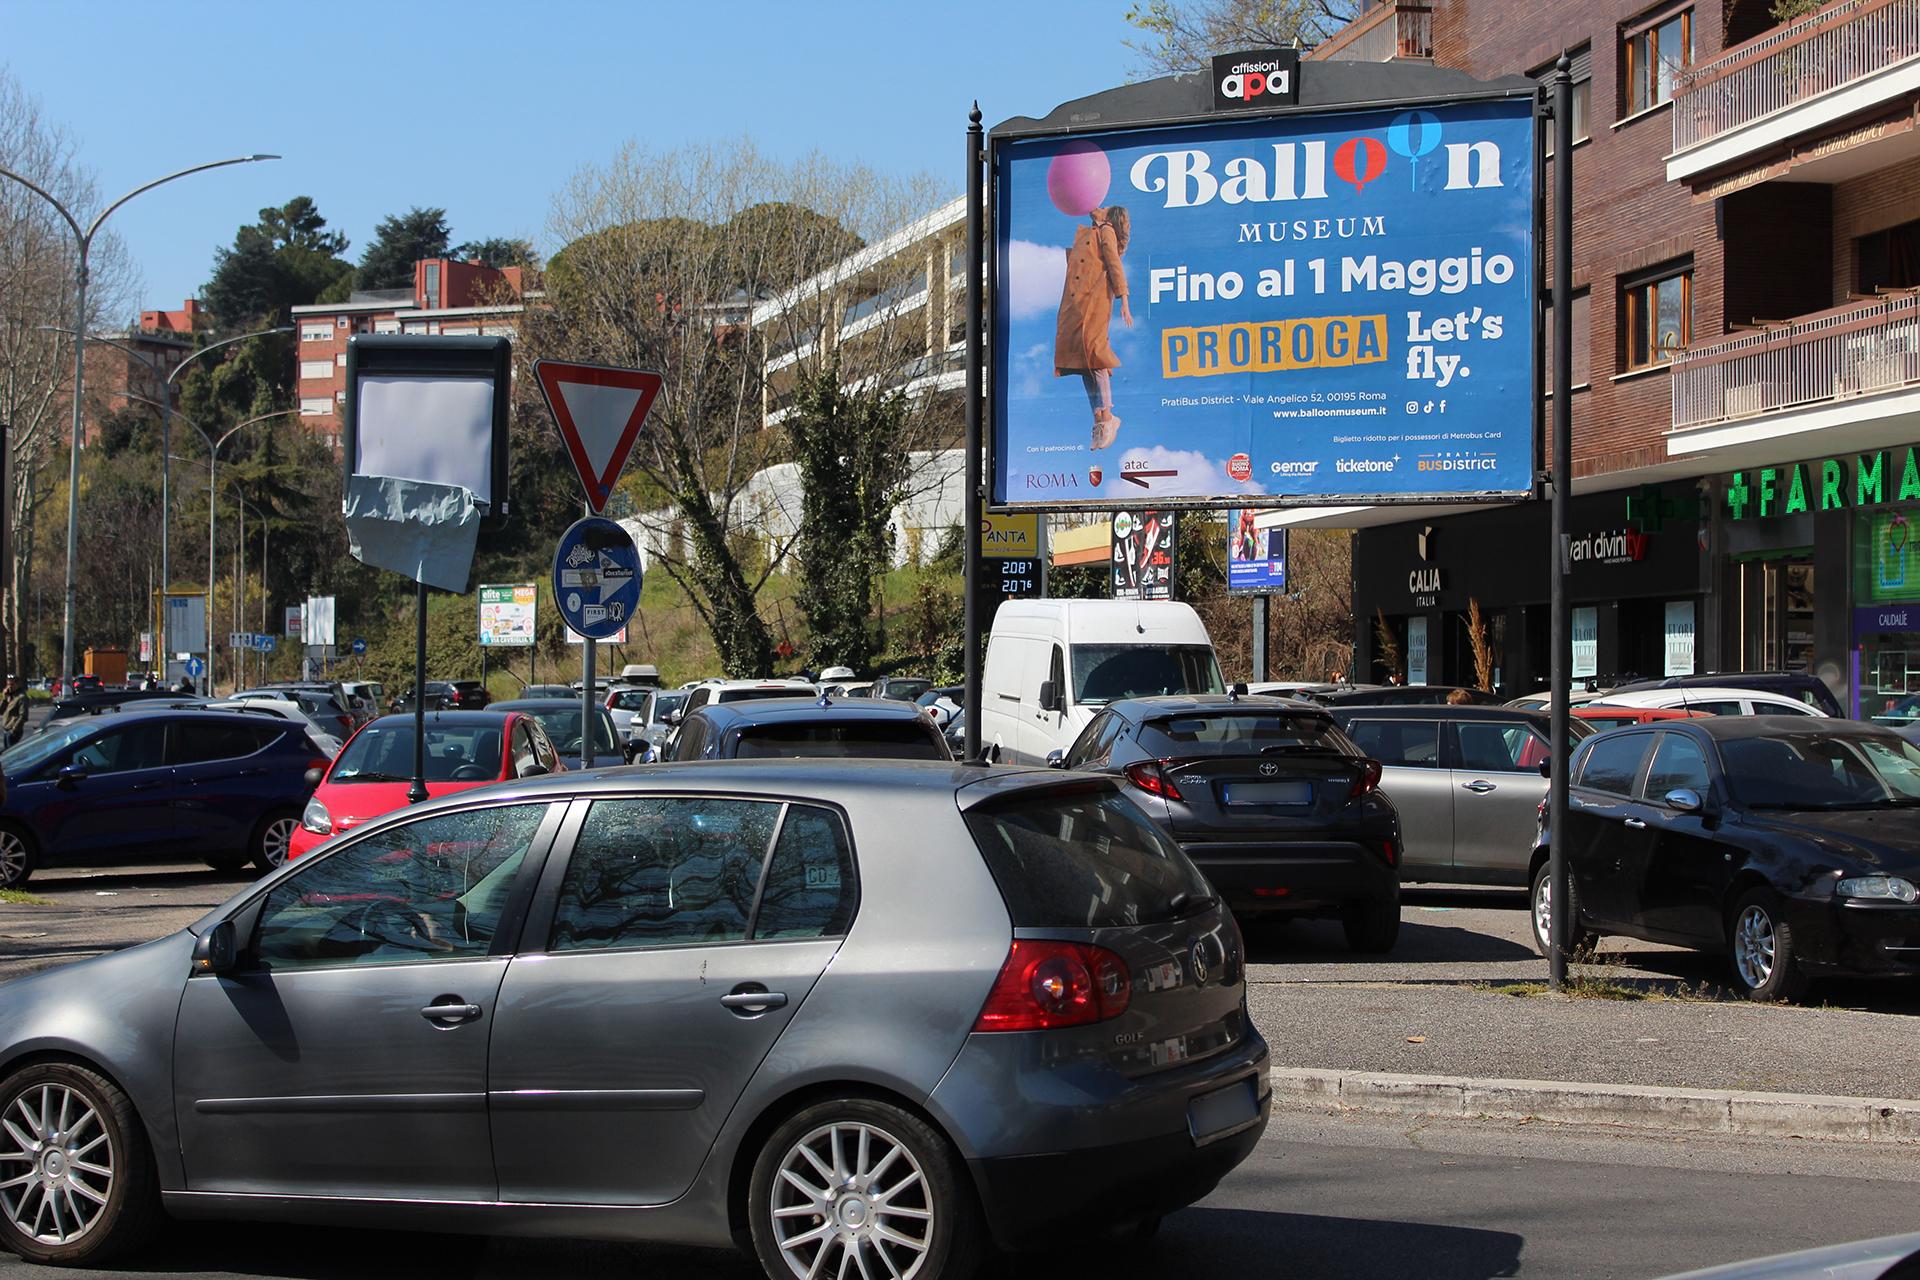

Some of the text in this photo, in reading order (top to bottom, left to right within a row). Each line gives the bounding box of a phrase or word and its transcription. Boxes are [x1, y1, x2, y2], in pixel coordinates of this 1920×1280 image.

[1231, 59, 1280, 75] affissioni
[1221, 69, 1290, 101] apa
[1130, 110, 1504, 209] Balloon
[1238, 216, 1386, 243] MUSEUM
[1150, 247, 1514, 303] Fino al 1 Maggio
[1407, 307, 1503, 342] Let's
[1167, 320, 1382, 373] PROROGA
[1407, 345, 1470, 387] fly.
[1161, 397, 1199, 407] PratiBus
[1201, 395, 1234, 405] District
[1243, 394, 1264, 404] Viale
[1267, 393, 1308, 405] Angelico
[1310, 393, 1325, 404] 52,
[1327, 392, 1356, 402] 00195
[1358, 391, 1387, 401] Roma
[1273, 407, 1387, 419] www.balloonmuseum.it
[1333, 435, 1362, 444] Biglietto
[1362, 434, 1387, 442] ridotto
[1388, 435, 1400, 443] per
[1404, 433, 1441, 443] possessori
[1442, 432, 1449, 440] di
[1450, 431, 1483, 440] Metrobus
[1484, 431, 1502, 440] Card
[1044, 445, 1076, 453] patrocinio
[1124, 459, 1149, 470] atac
[1335, 458, 1394, 473] ticketone
[1026, 473, 1078, 489] ROMA
[1760, 447, 1920, 517] FARMA
[1594, 528, 1642, 561] divinity
[1409, 568, 1441, 594] CALIA
[1416, 595, 1436, 608] ITALIA
[1115, 1031, 1144, 1045] GOLF
